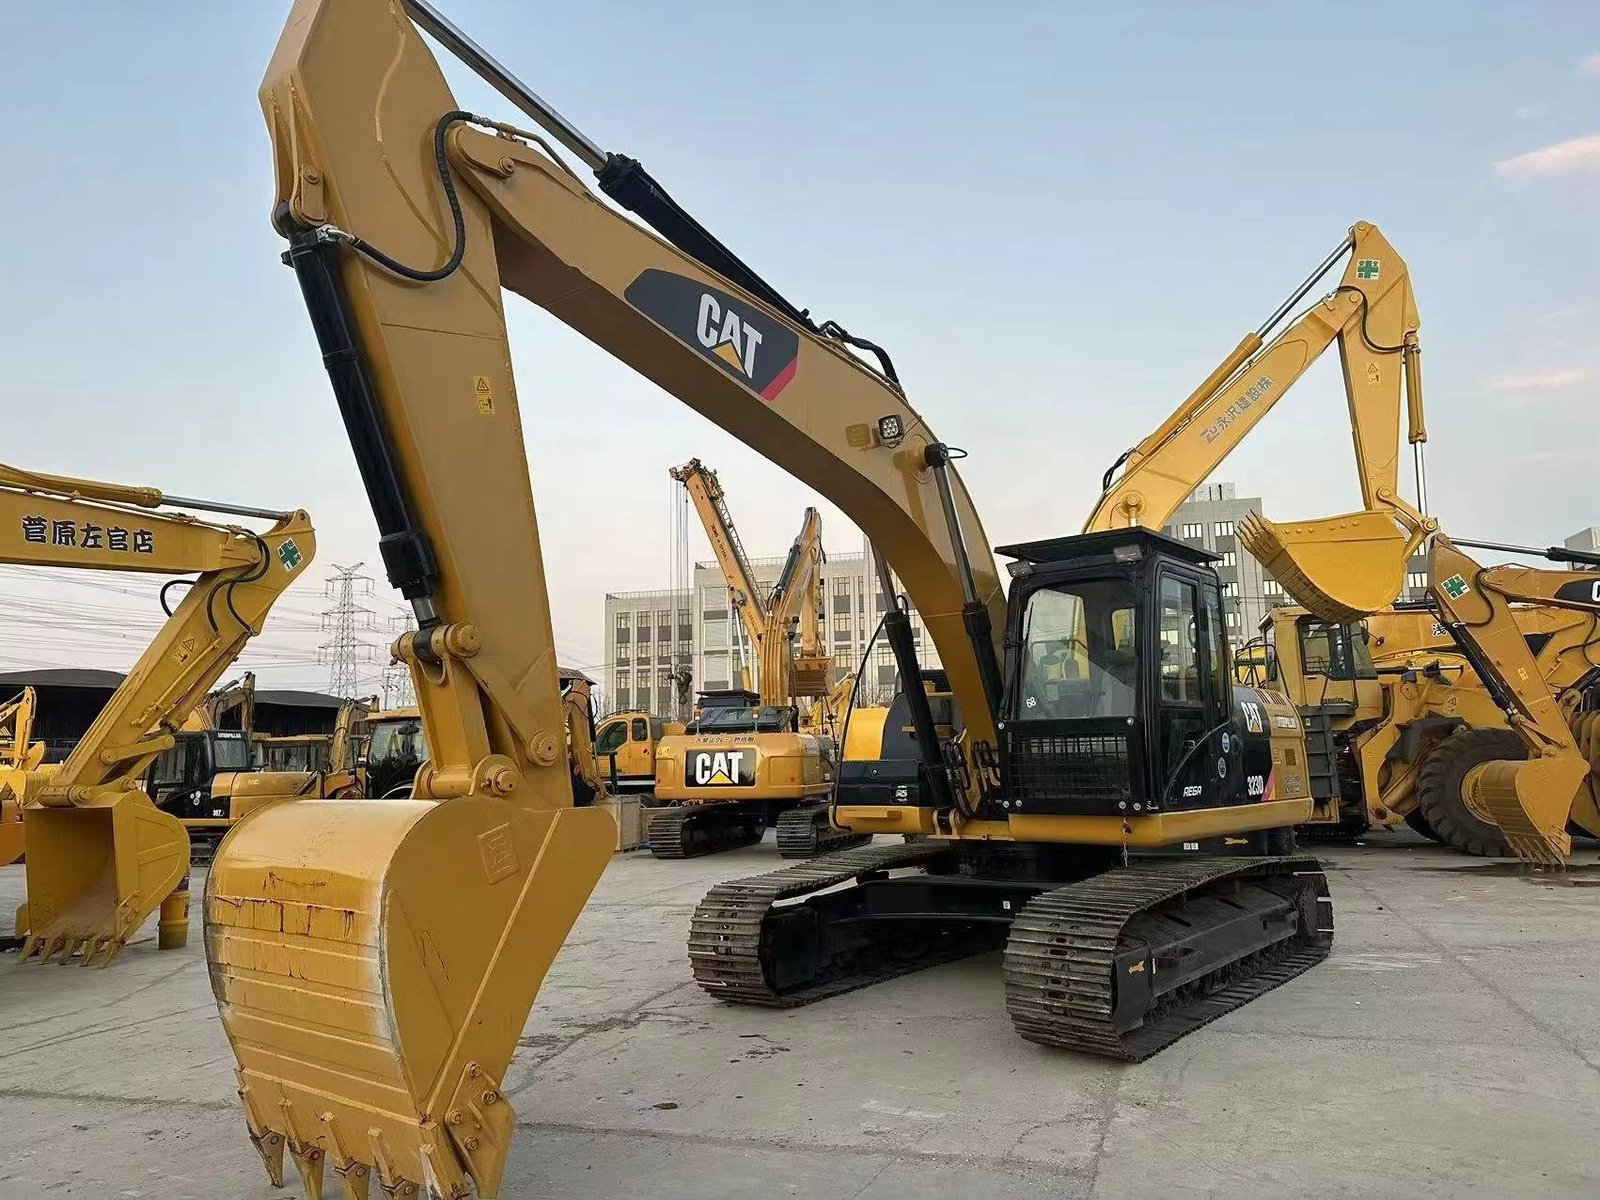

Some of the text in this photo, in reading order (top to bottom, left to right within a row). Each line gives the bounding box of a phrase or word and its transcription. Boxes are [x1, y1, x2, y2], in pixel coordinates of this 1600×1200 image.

[697, 293, 763, 379] CAT
[22, 515, 154, 553] 菅原左官店
[1241, 702, 1263, 732] CAT
[695, 752, 743, 785] CAT
[1247, 775, 1264, 796] 323D
